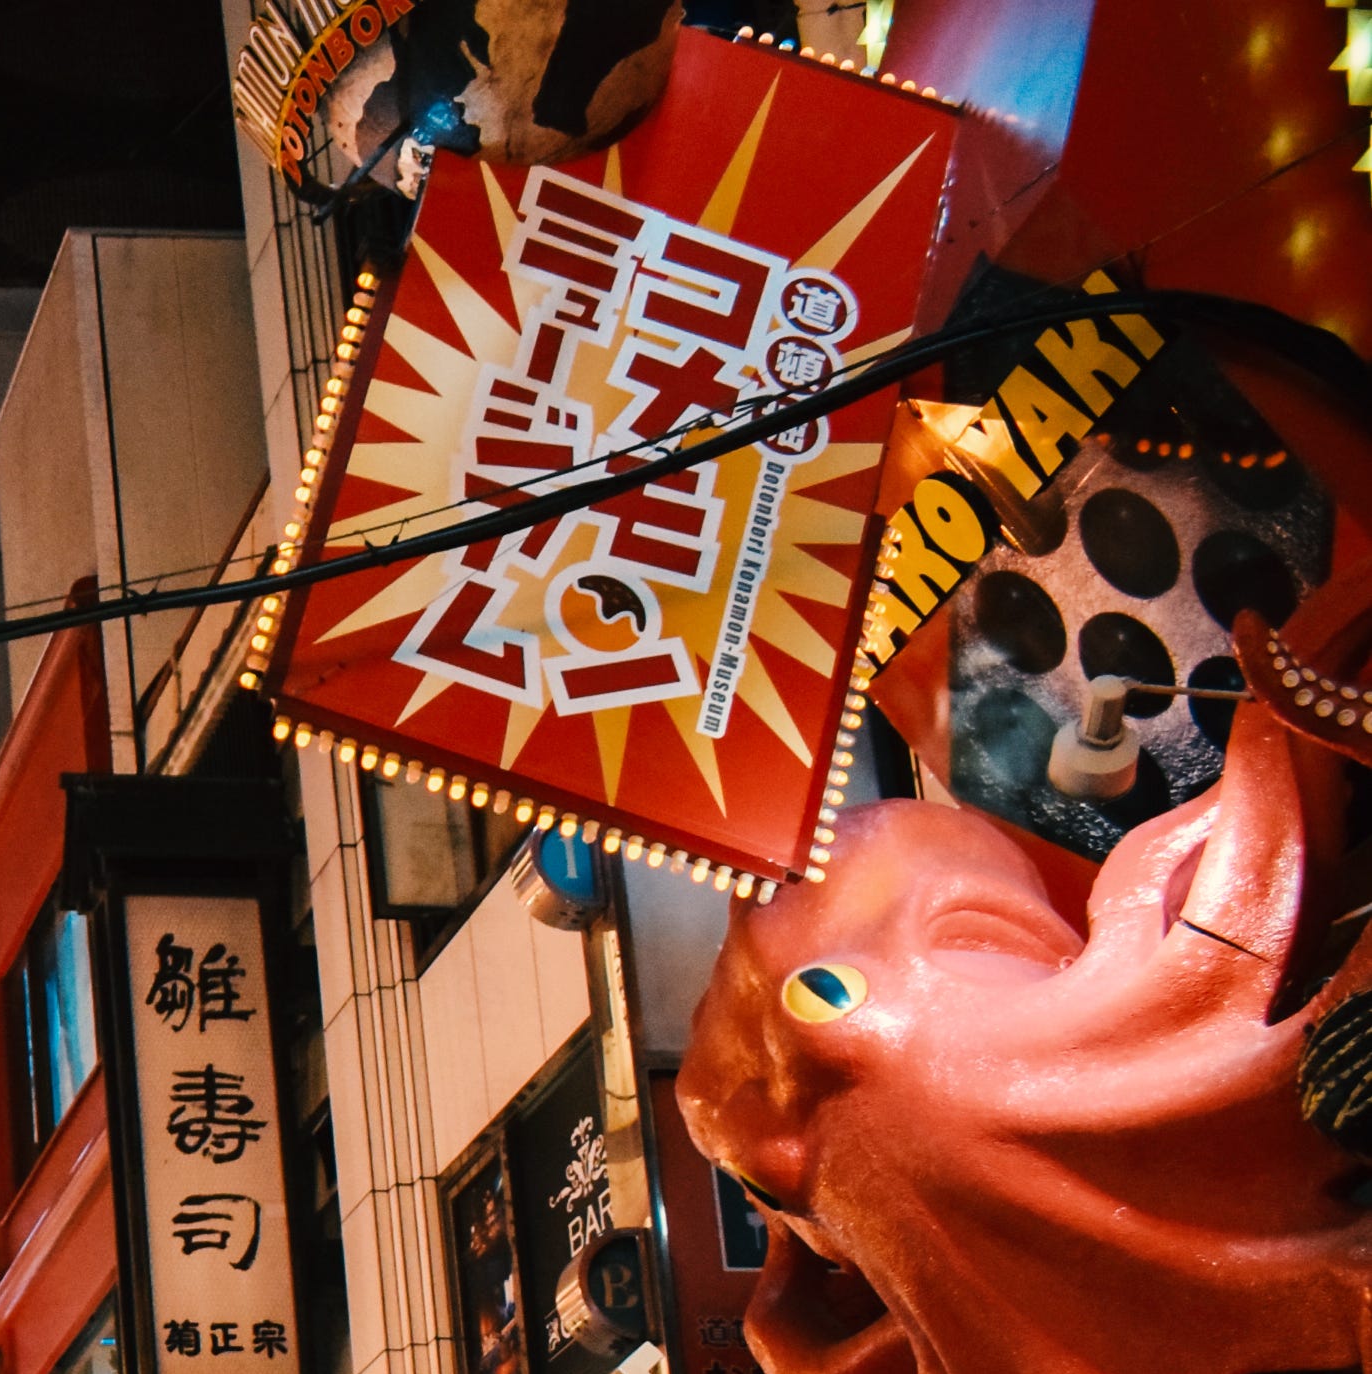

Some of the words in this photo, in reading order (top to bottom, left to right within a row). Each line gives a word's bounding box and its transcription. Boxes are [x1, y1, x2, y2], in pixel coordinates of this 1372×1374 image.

[955, 270, 1165, 499] YAKI
[745, 461, 785, 557] Dotonbori
[163, 1319, 288, 1359] 菊正宗
